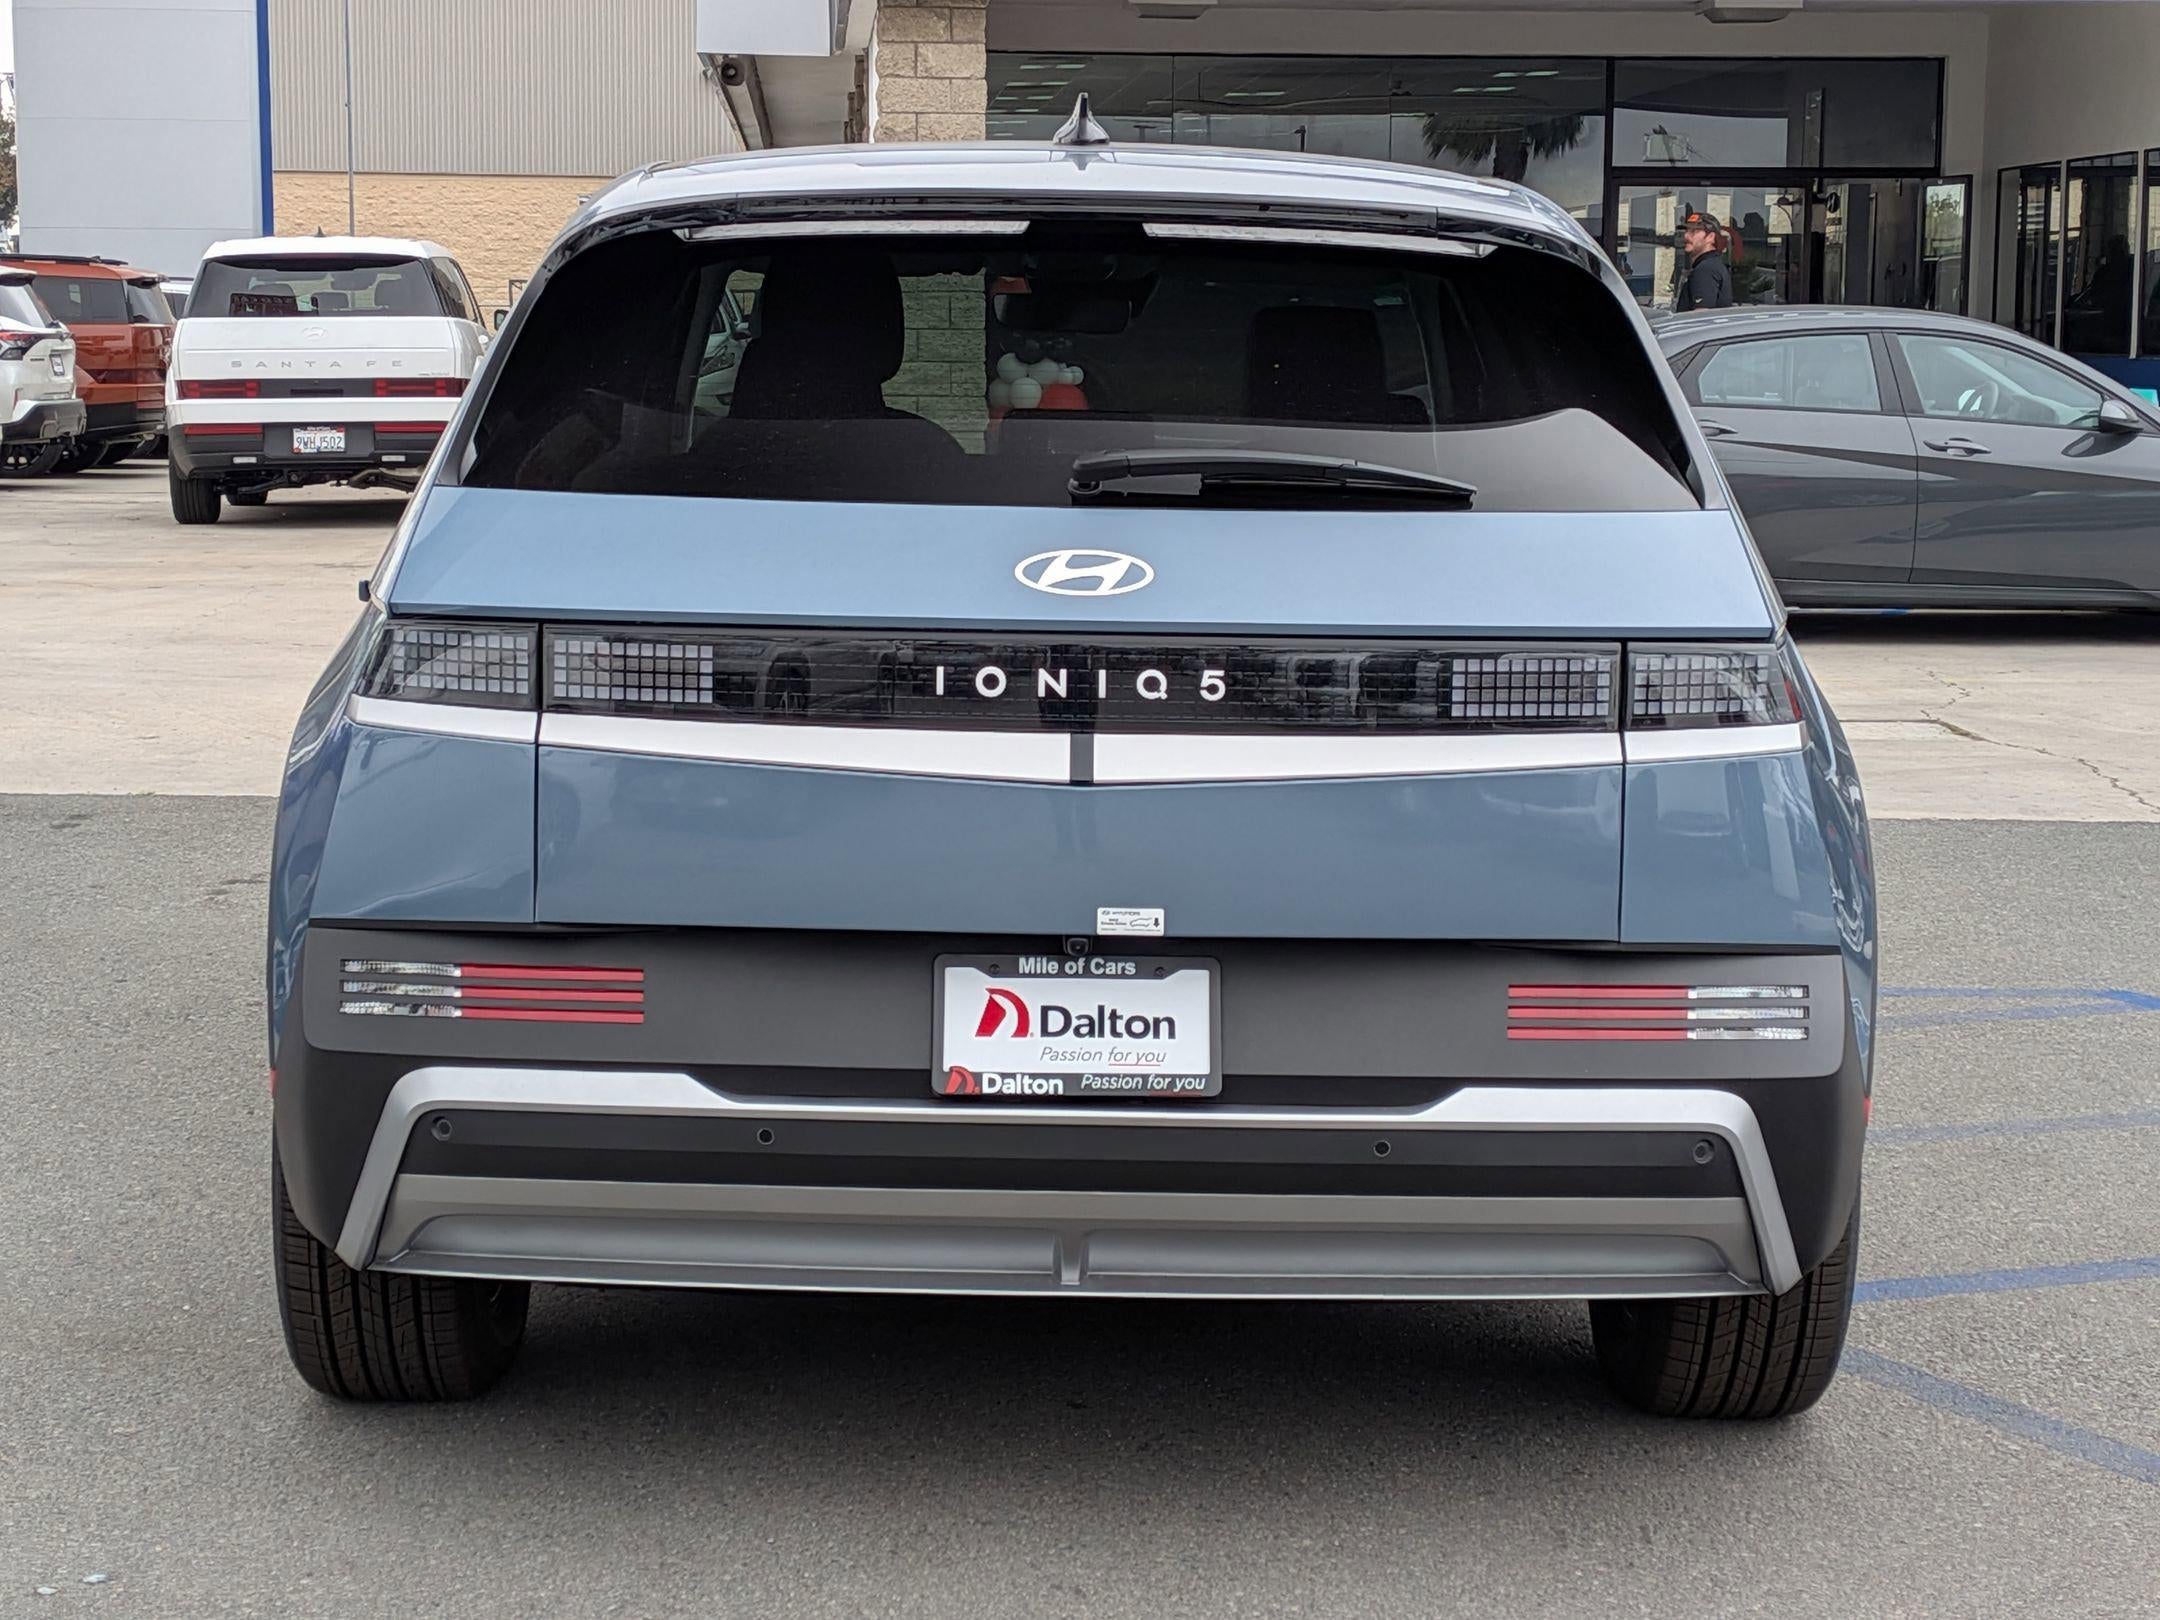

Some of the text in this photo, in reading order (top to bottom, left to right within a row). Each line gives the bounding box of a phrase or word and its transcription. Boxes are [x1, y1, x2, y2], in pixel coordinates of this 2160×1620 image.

[231, 360, 403, 369] SANTA FE
[935, 665, 1227, 702] IONIQ 5
[1018, 957, 1136, 976] Mile of Cars
[1039, 1004, 1177, 1040] Dalton
[1039, 1046, 1168, 1065] Passion for you
[981, 1072, 1207, 1095] Dalton Passion for you
